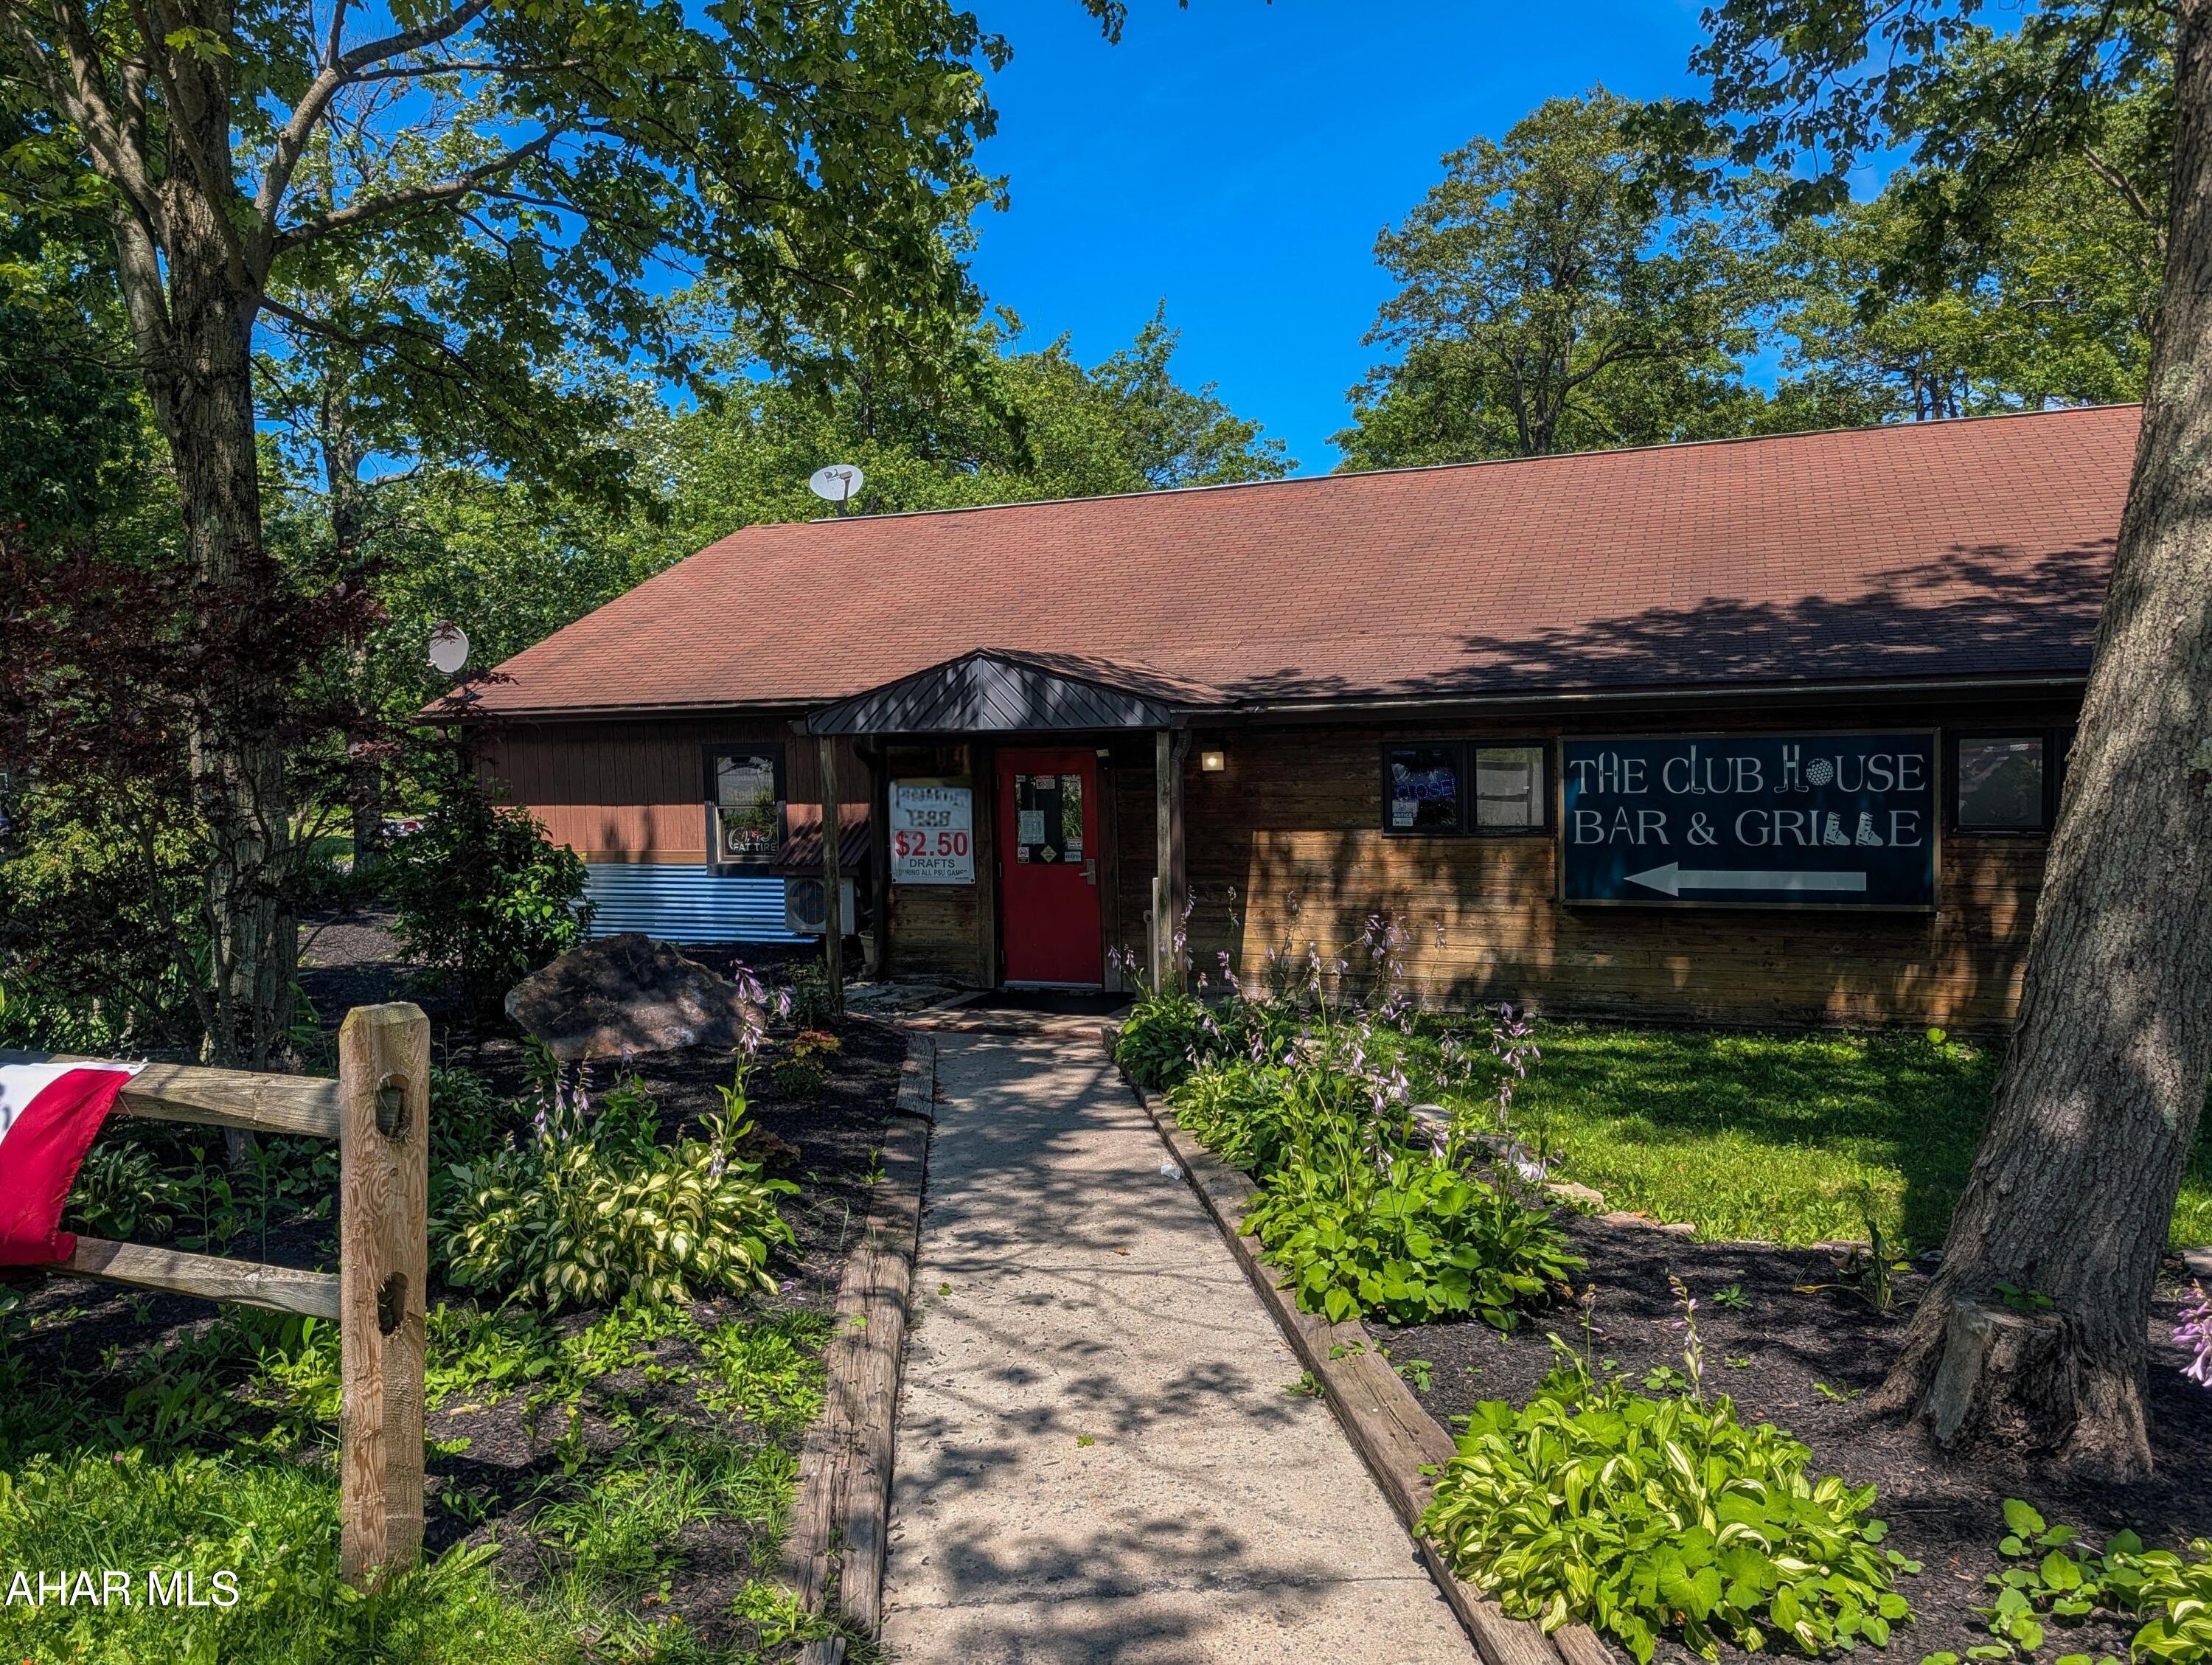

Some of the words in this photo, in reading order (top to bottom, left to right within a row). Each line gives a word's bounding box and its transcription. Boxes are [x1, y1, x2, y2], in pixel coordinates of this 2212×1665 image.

[1570, 751, 1649, 795] THE
[1663, 745, 1764, 795] CLUB
[1773, 745, 1926, 793] HOUSE
[1573, 807, 1669, 845] BAR
[1687, 812, 1719, 846] &
[1735, 810, 1922, 847] GRILLE
[733, 843, 751, 852] FAT
[754, 843, 776, 852] TIRE
[895, 830, 968, 859] $2.50
[909, 859, 956, 868] DRAFTS
